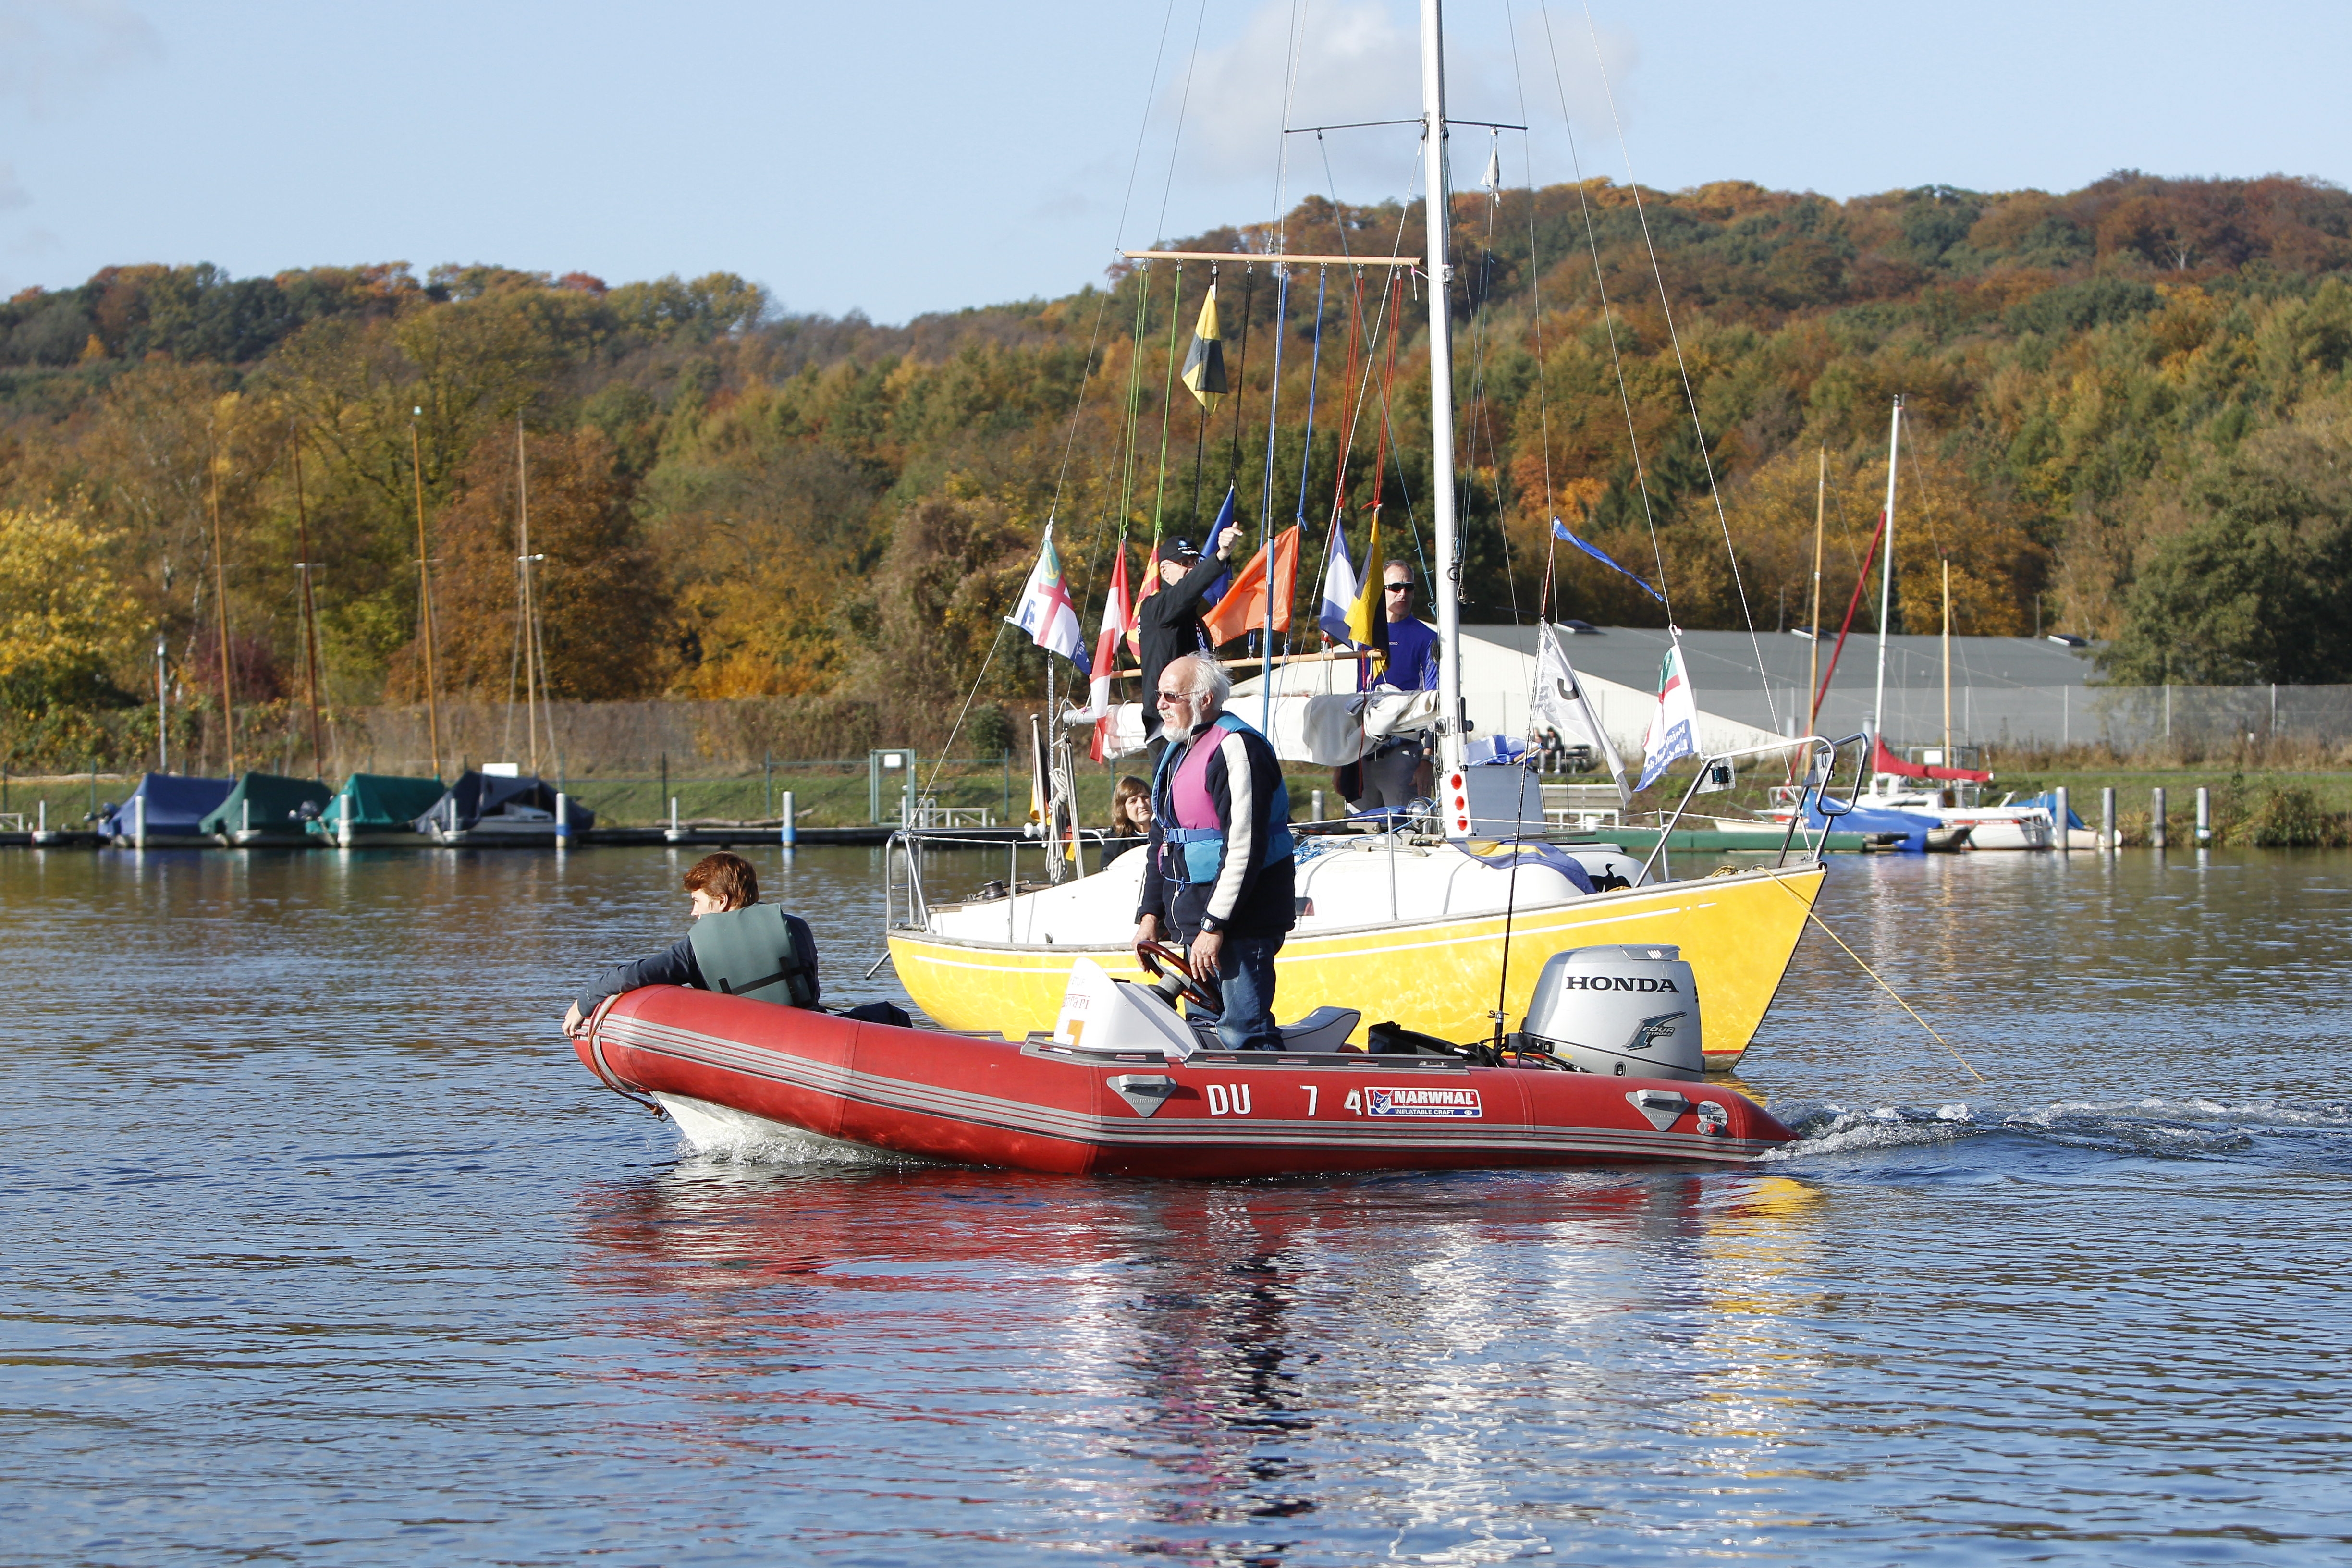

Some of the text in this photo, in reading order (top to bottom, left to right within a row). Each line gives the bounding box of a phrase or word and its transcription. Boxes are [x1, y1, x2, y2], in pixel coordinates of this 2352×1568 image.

[1566, 976, 1679, 993] HONDA
[1206, 1084, 1251, 1115] DU
[1299, 1085, 1318, 1116] 7
[1394, 1090, 1474, 1105] NARWHAL
